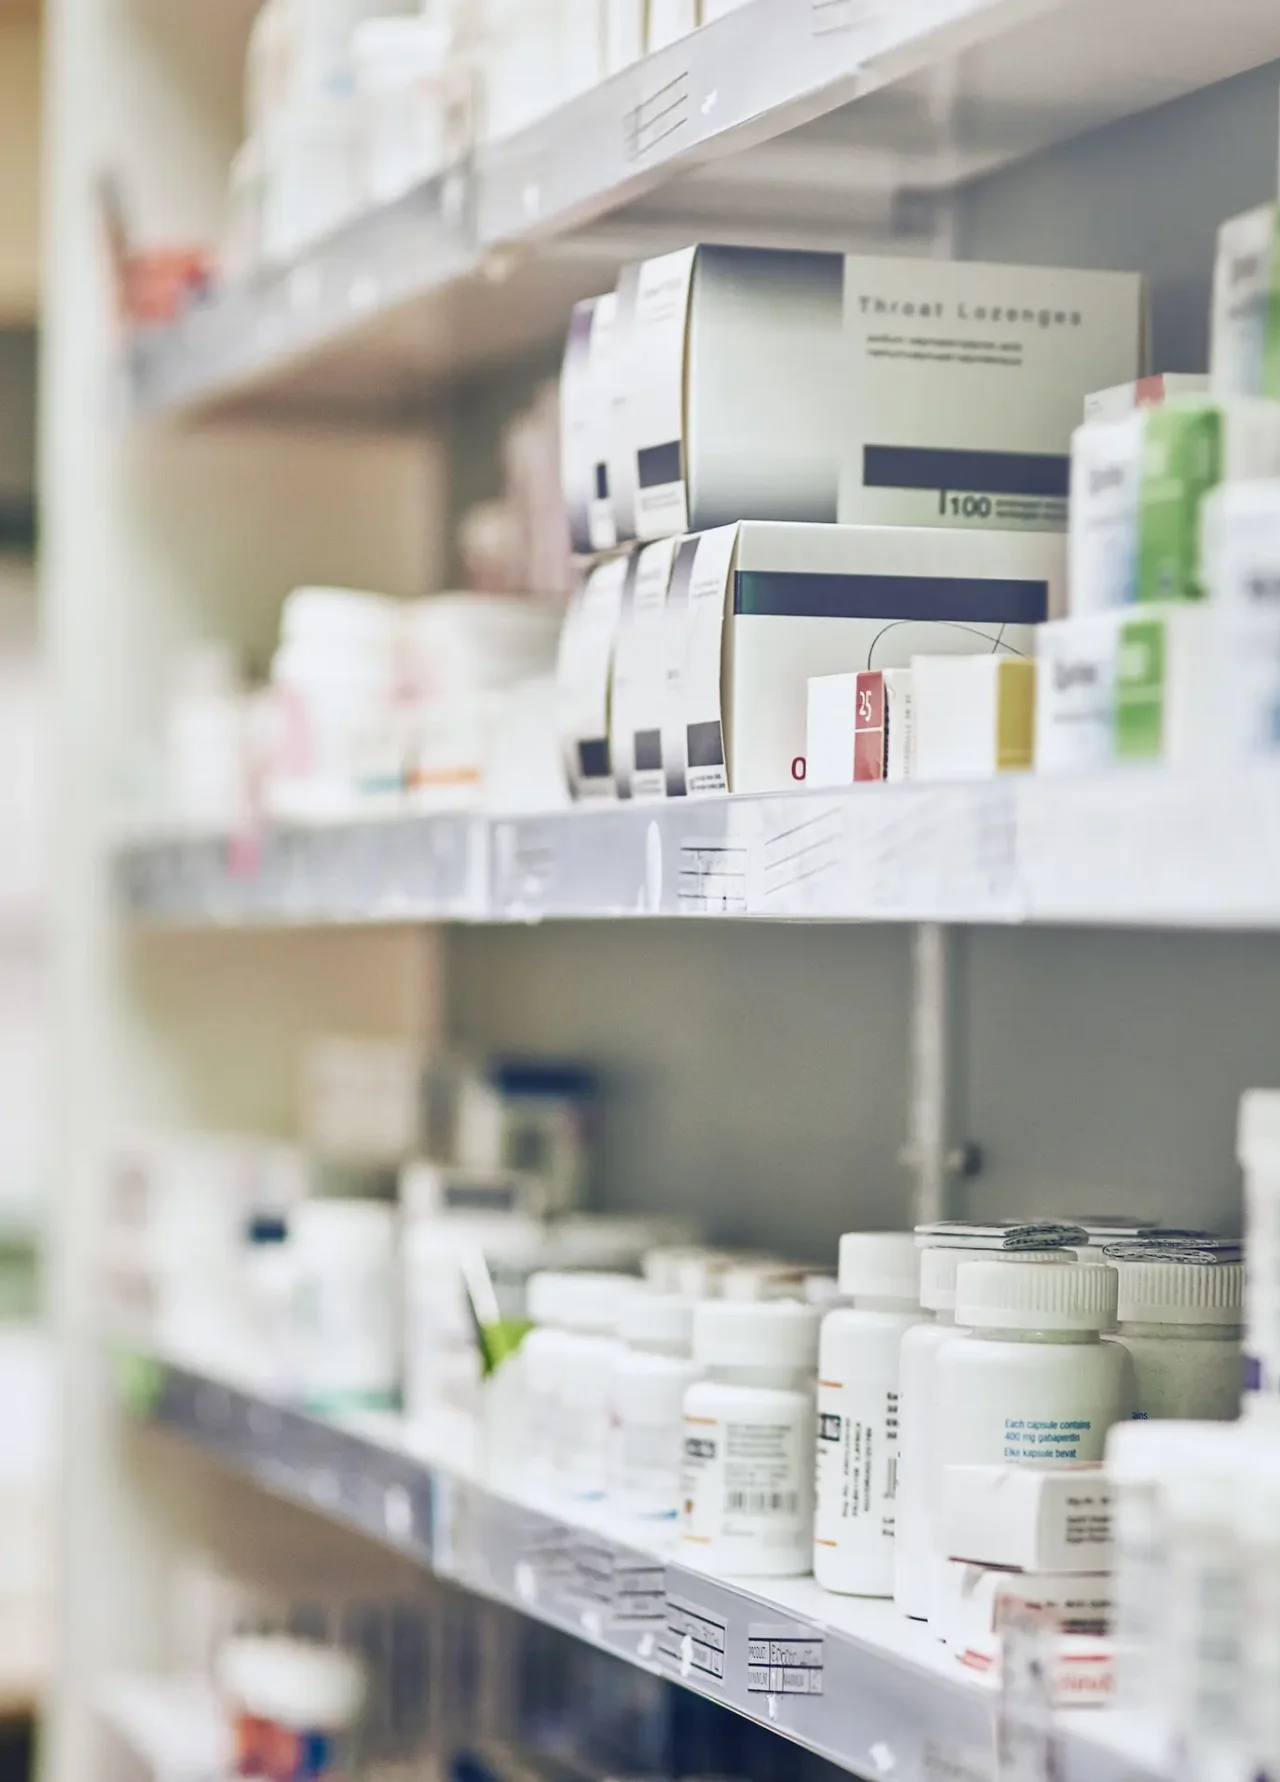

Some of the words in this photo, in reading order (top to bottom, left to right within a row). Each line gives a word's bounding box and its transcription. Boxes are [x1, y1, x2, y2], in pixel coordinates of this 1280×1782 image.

[859, 296, 943, 317] Throat
[957, 302, 1081, 328] Lozenges
[949, 495, 992, 519] 100
[859, 690, 872, 722] 25
[1005, 1419, 1025, 1429] Each
[1026, 1420, 1058, 1430] capsule
[1059, 1420, 1091, 1430] contains
[1004, 1432, 1020, 1441] 400
[1023, 1434, 1036, 1443] mg
[1038, 1432, 1081, 1443] gabapentin
[1023, 1448, 1054, 1459] kapsule
[1055, 1448, 1077, 1458] bevat
